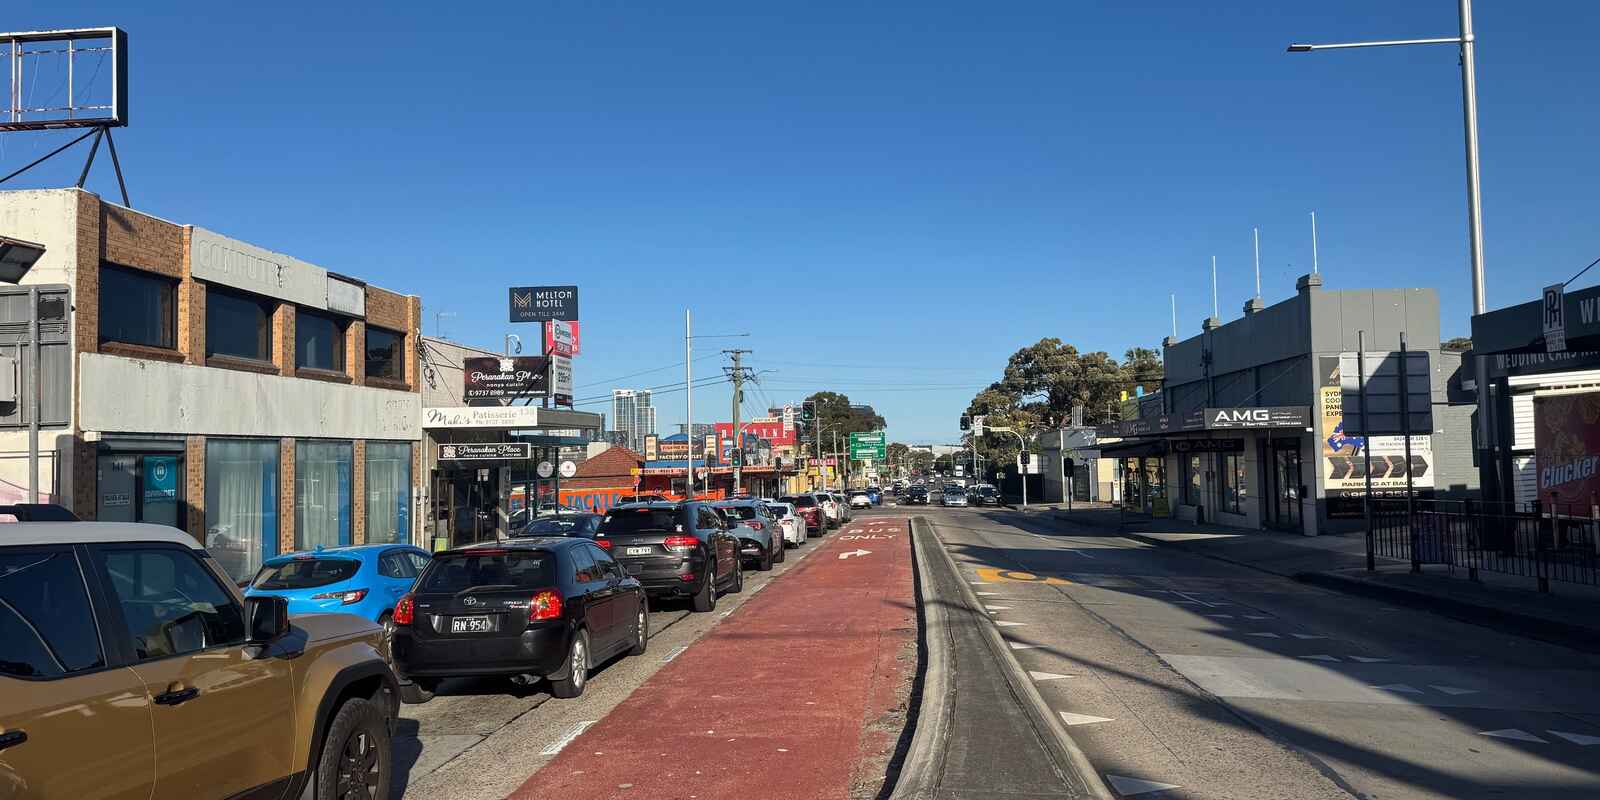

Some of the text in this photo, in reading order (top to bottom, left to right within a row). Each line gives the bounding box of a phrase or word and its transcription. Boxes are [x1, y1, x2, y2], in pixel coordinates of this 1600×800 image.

[536, 291, 572, 299] MELTON
[536, 300, 563, 308] HOTEL
[471, 372, 515, 383] Peranakan
[473, 410, 518, 419] Patisserie
[1215, 410, 1269, 422] AMG
[458, 446, 497, 455] Peranakan
[498, 445, 521, 454] Place
